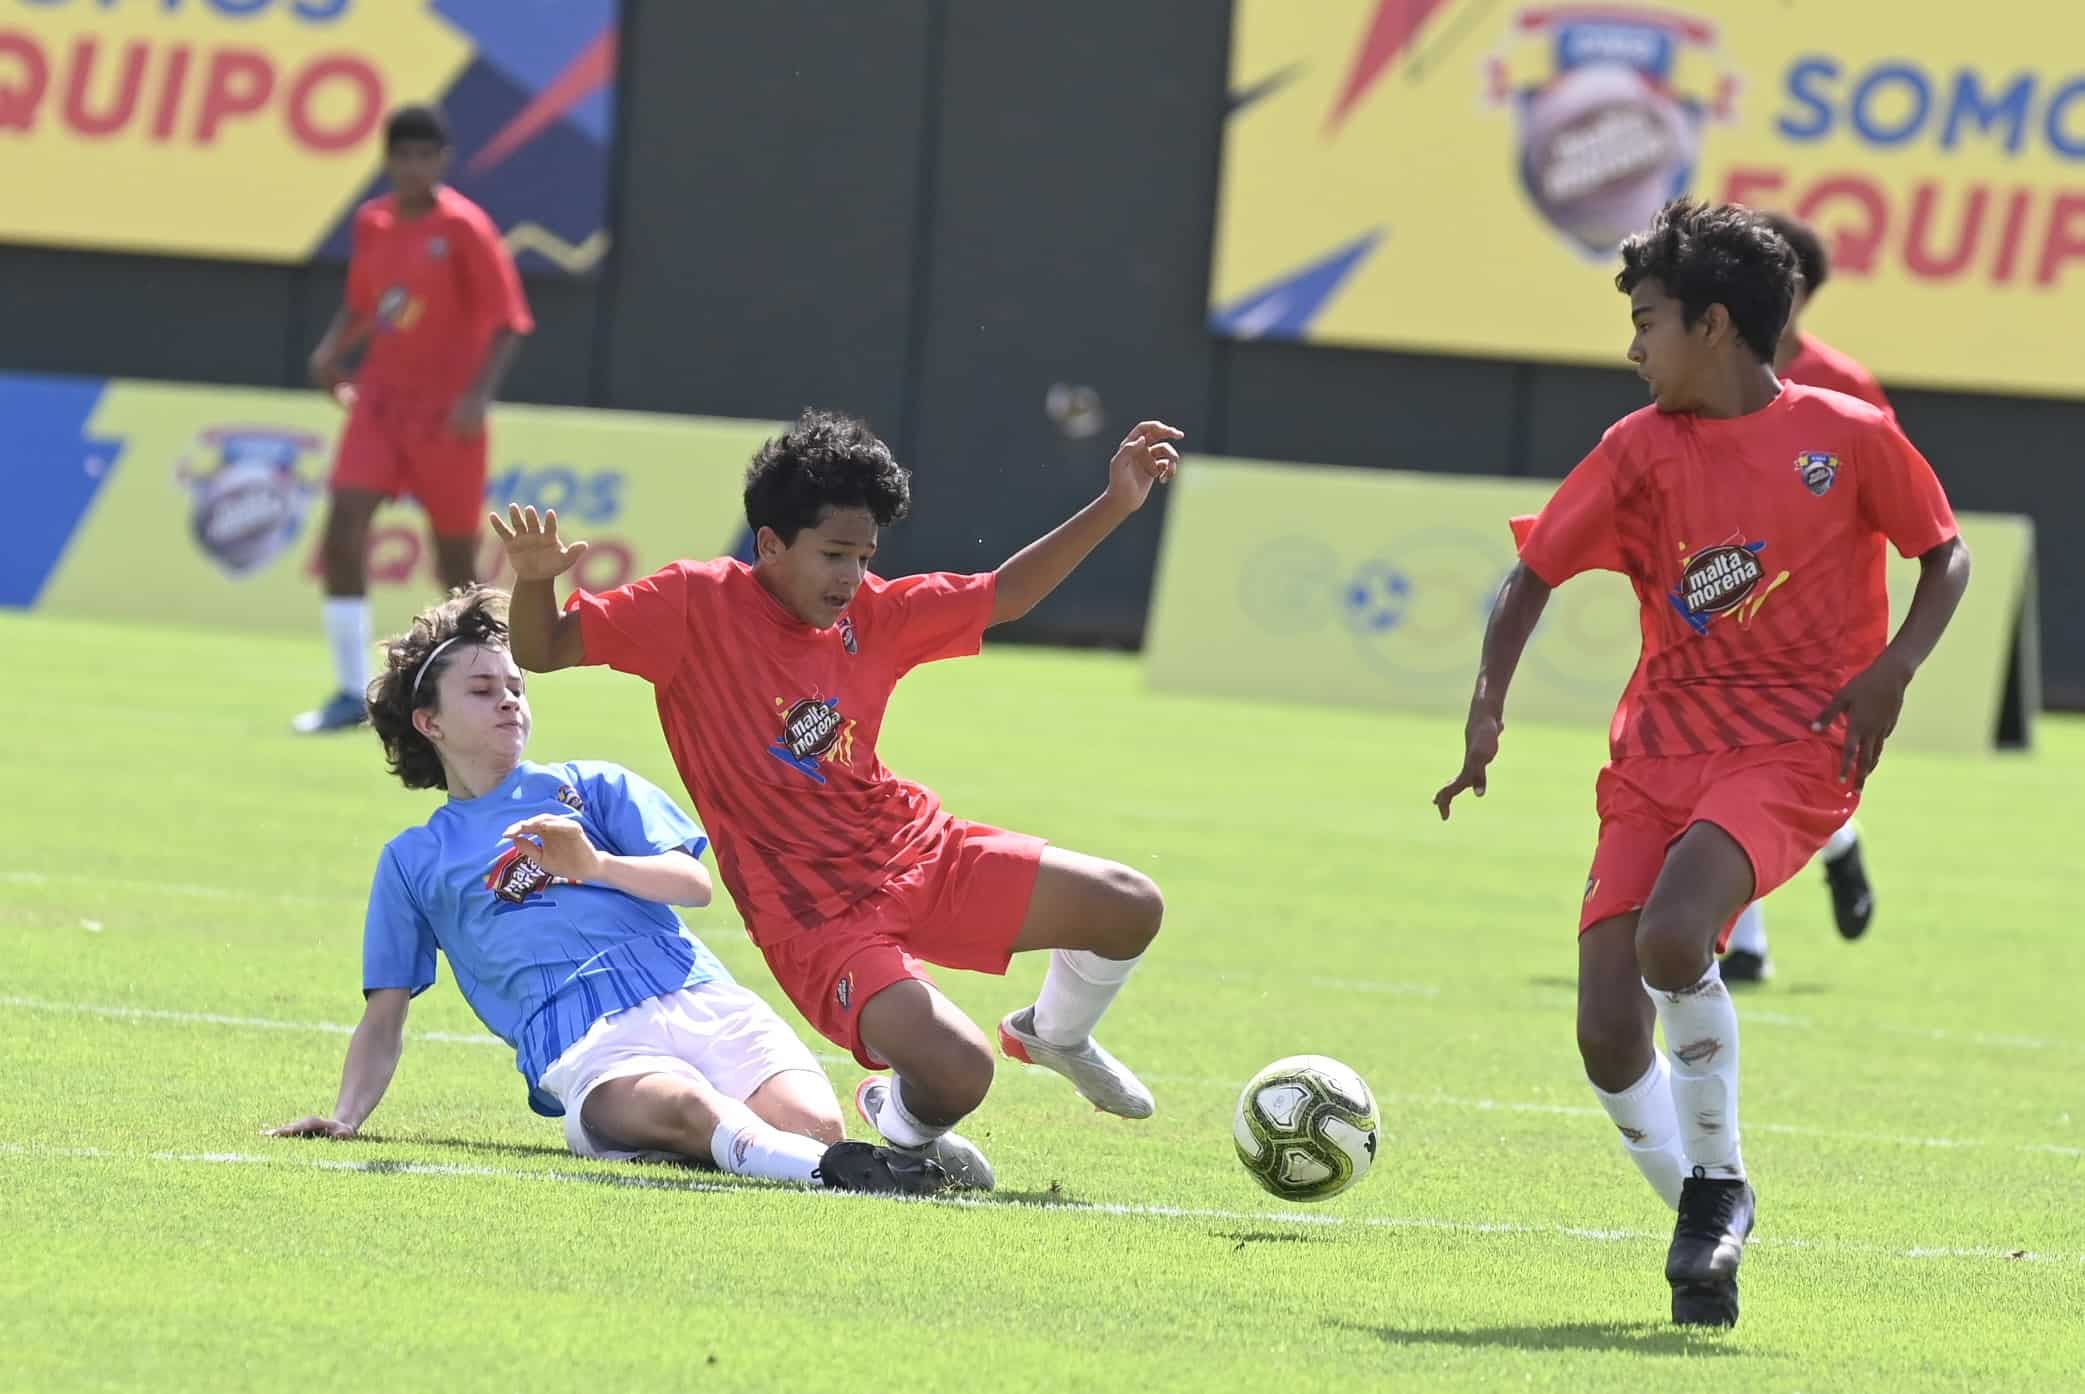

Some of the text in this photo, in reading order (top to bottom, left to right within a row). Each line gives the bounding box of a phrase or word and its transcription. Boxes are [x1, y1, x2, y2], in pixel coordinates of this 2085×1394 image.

[1688, 562, 1757, 609] morena
[1690, 552, 1741, 590] malta
[792, 704, 830, 737] malta
[793, 712, 840, 755] morena
